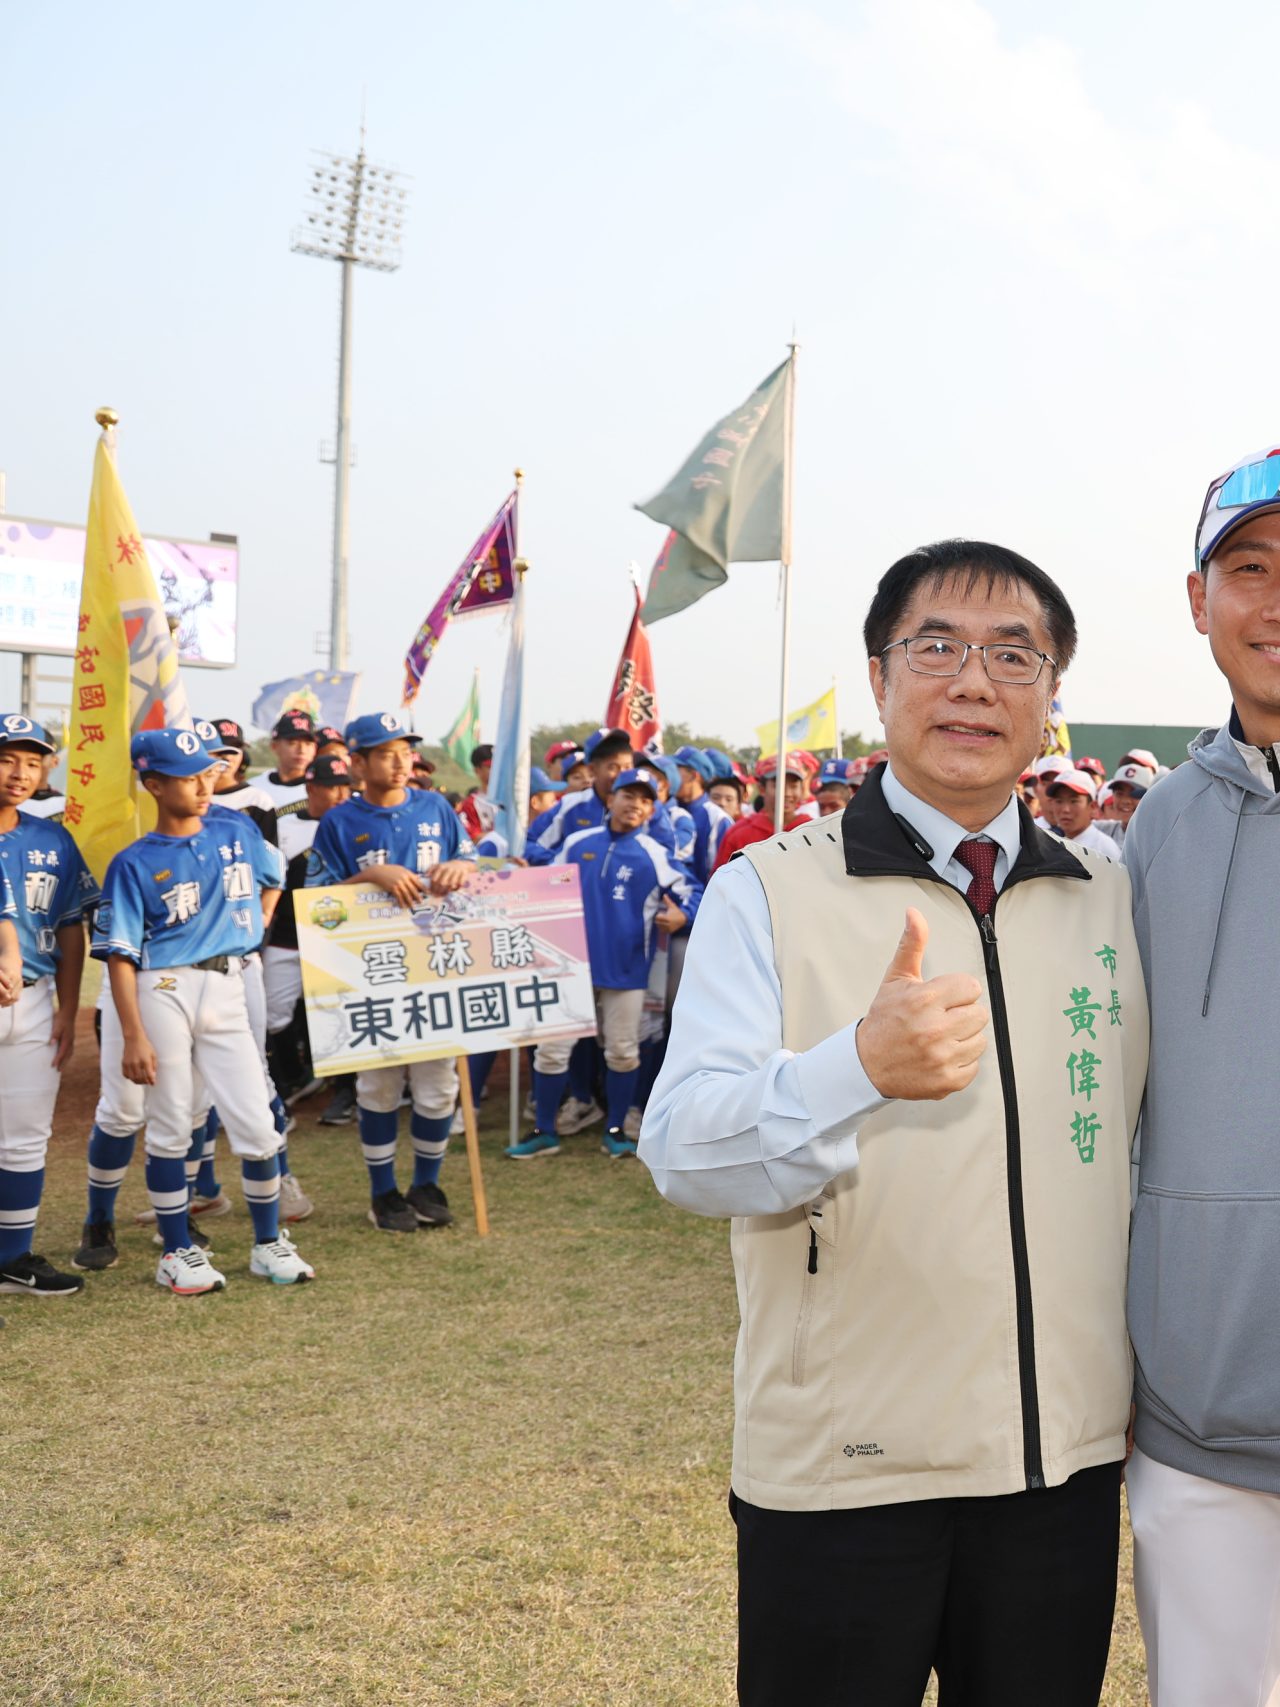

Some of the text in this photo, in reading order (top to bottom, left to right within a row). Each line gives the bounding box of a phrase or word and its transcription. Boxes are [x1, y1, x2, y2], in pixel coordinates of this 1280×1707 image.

[361, 925, 536, 986] 雲林縣
[1094, 943, 1123, 1027] 市長
[344, 975, 560, 1049] 東和國中
[1062, 986, 1103, 1164] 黃偉哲
